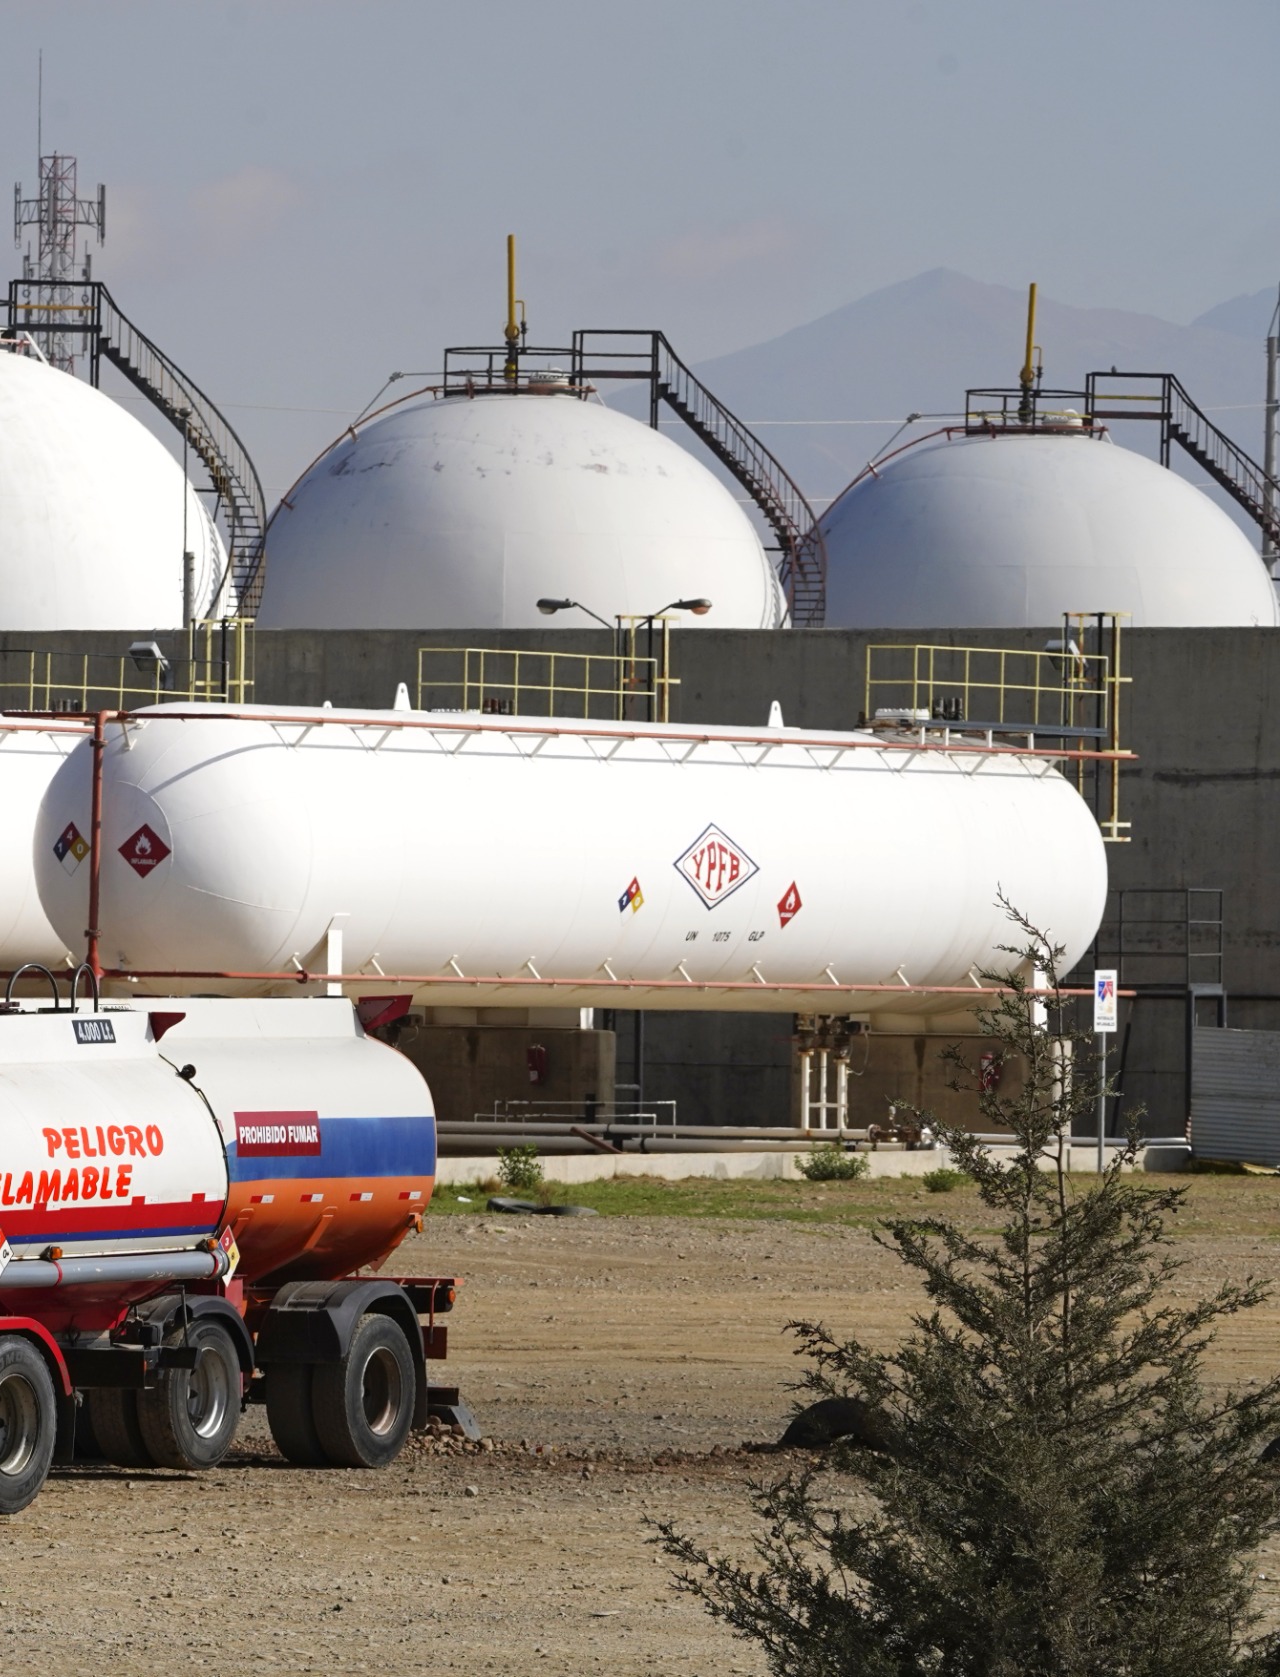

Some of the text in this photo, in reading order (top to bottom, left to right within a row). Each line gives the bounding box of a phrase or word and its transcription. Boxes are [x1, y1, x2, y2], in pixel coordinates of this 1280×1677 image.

[66, 830, 73, 840] 4
[77, 844, 84, 854] 0
[692, 841, 740, 892] YPFB
[685, 931, 765, 942] UN 1075 GLP
[78, 1022, 114, 1041] 4.000 Lt.
[42, 1124, 164, 1159] PELIGRO
[239, 1125, 318, 1144] PROHIBIDO FUMAR
[225, 1237, 230, 1246] 3
